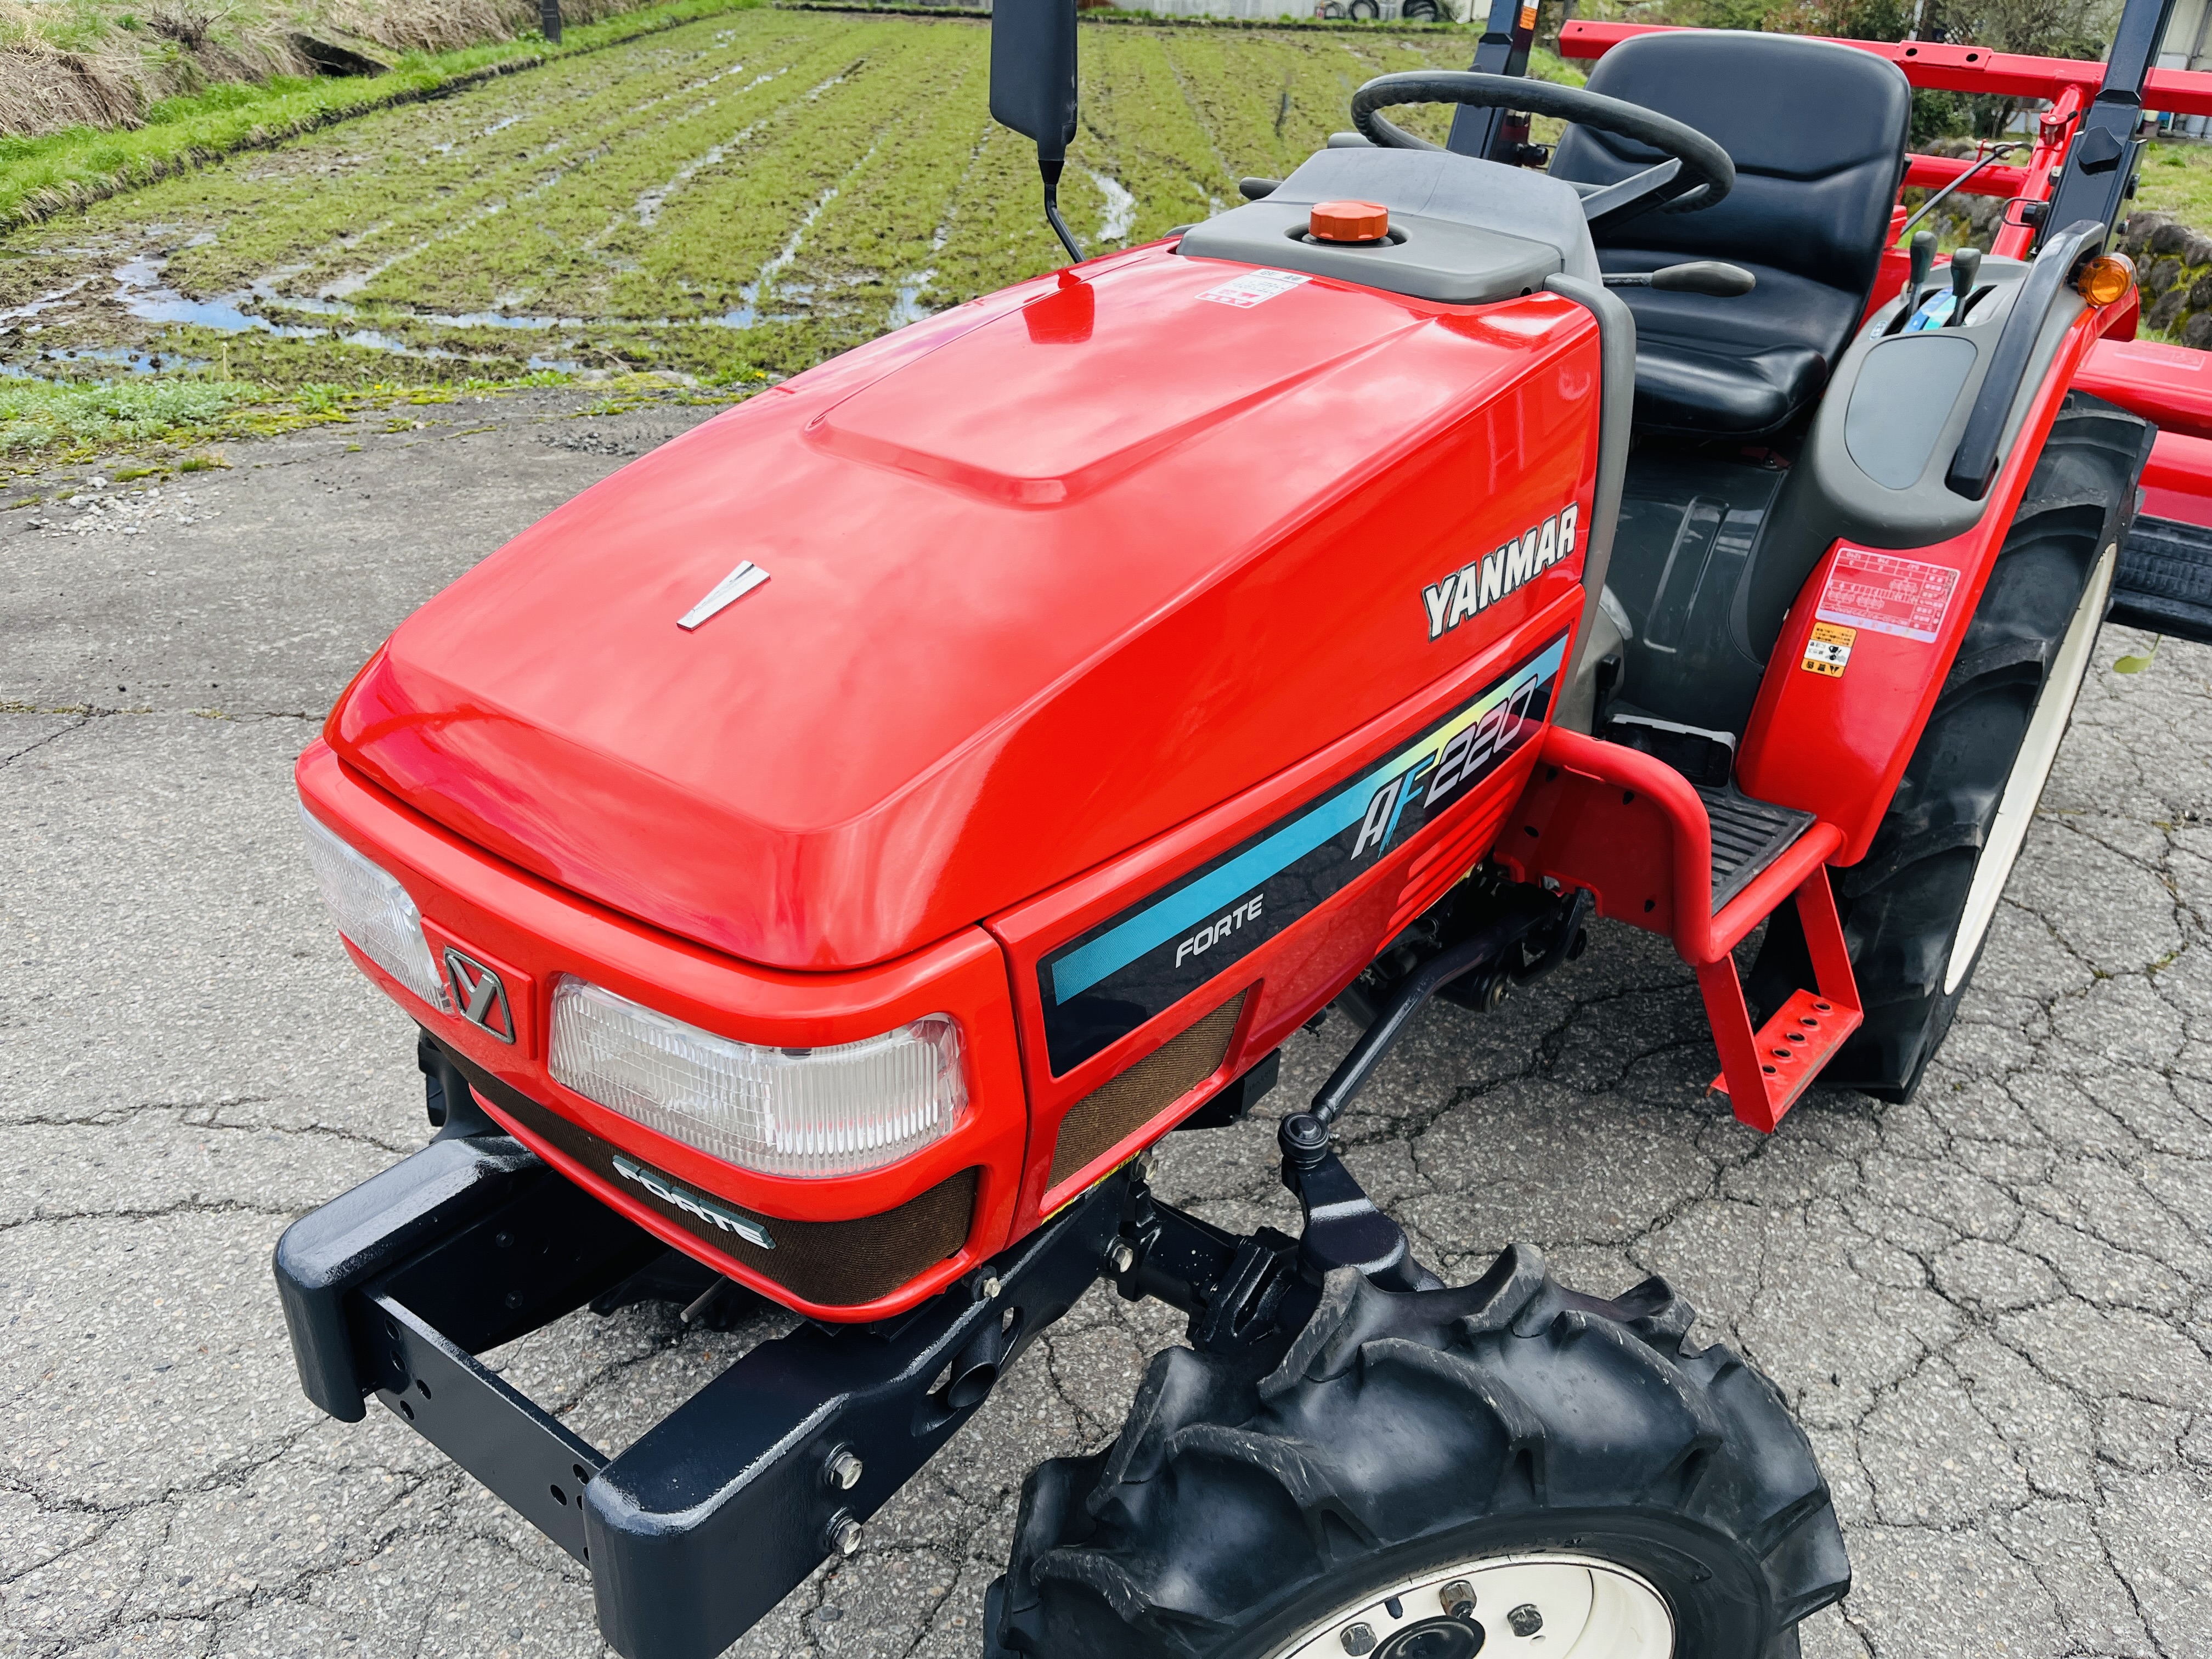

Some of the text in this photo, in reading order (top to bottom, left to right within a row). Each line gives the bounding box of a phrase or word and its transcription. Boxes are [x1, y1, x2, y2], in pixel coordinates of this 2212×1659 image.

[1421, 501, 1578, 642] YANMAR
[1350, 674, 1538, 860] AF220
[1175, 893, 1264, 969] FORTE
[612, 1154, 776, 1250] FORTE
